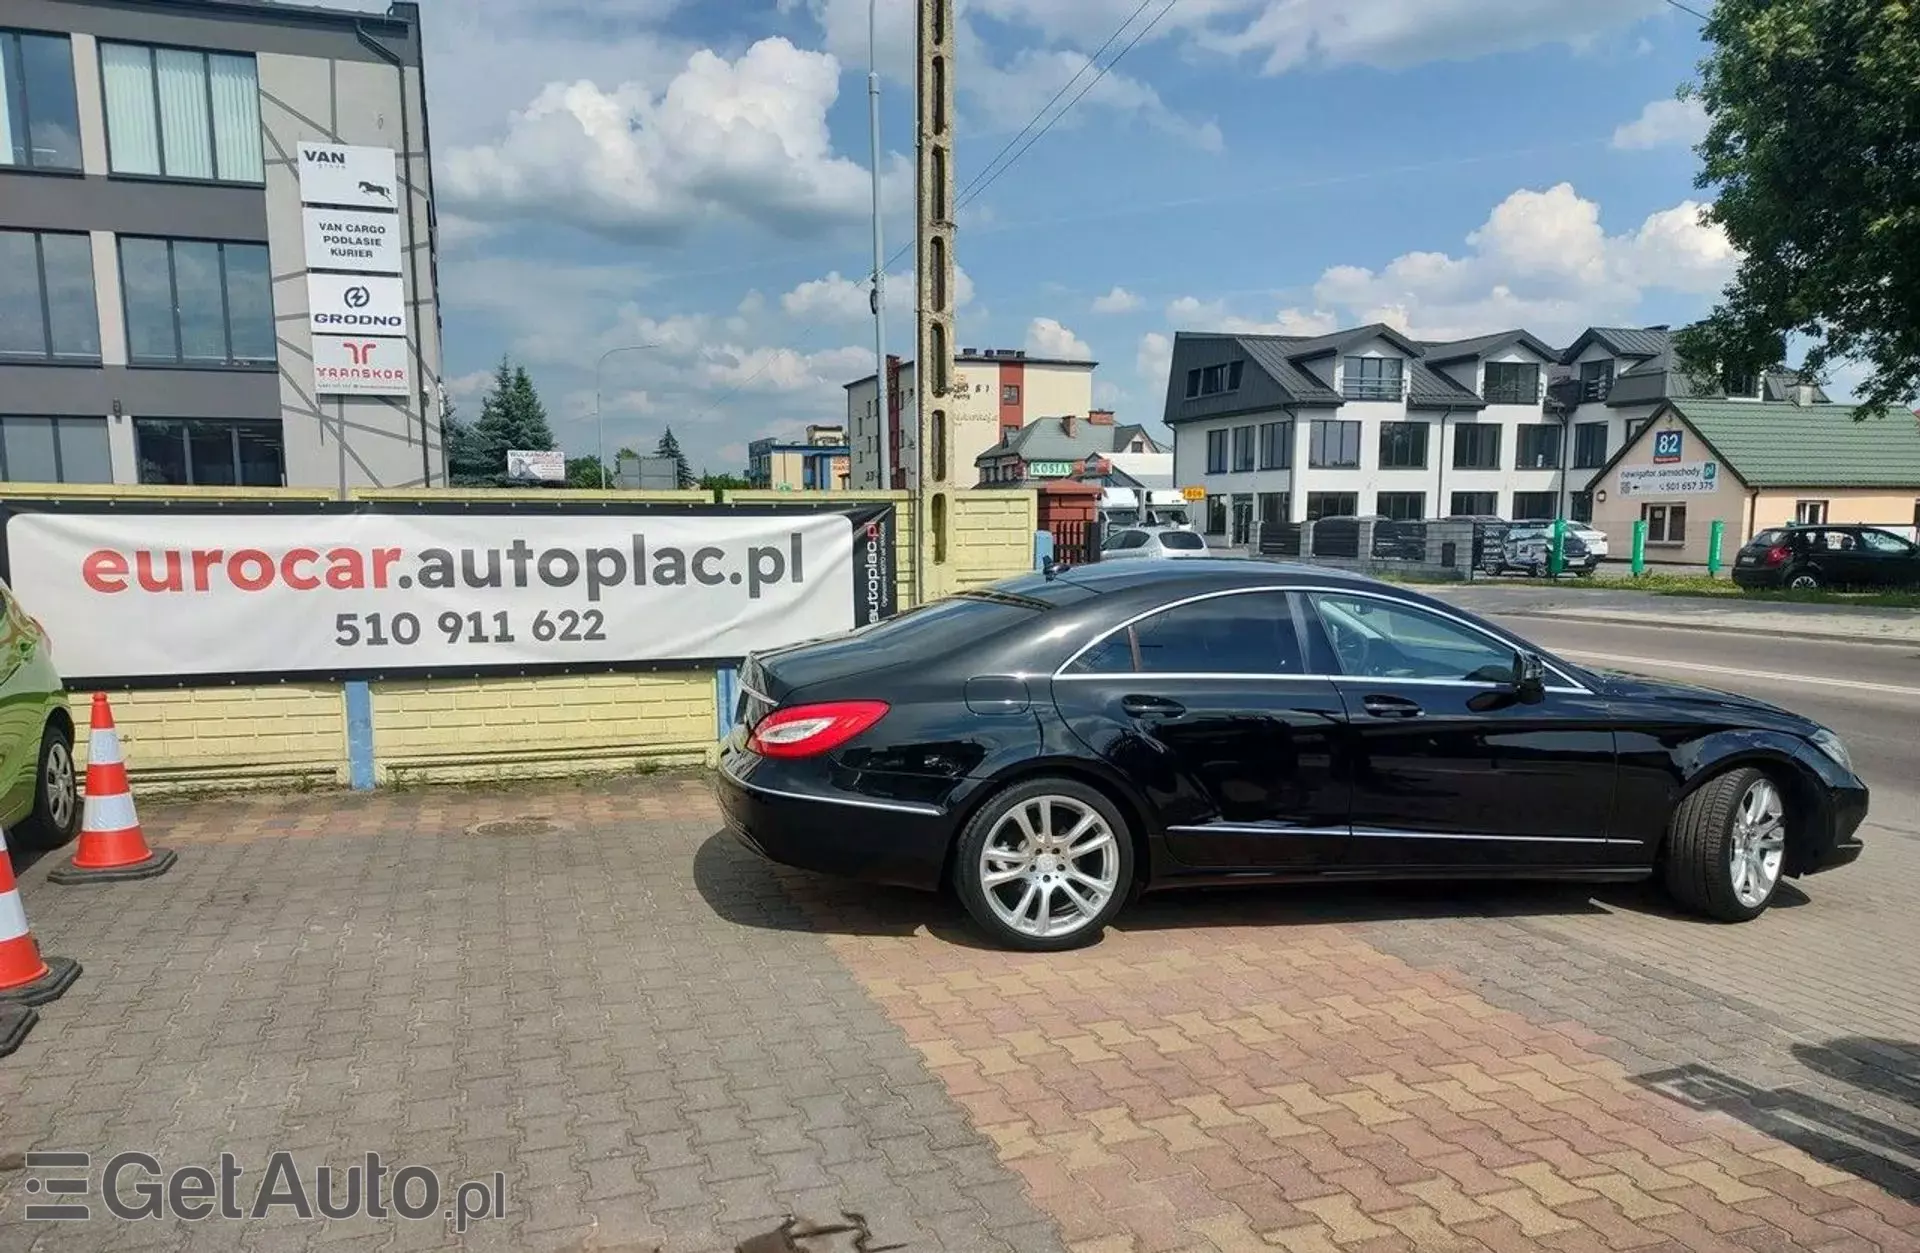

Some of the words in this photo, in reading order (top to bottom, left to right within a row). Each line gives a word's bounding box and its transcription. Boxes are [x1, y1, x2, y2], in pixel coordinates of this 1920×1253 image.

[304, 150, 345, 163] VAN
[319, 222, 342, 232] VAN
[345, 223, 386, 234] CARGO
[323, 235, 382, 246] PODLASIE
[330, 248, 373, 258] KURIER
[314, 313, 402, 327] GRODNO
[316, 367, 404, 379] TRANSKOR
[1659, 433, 1679, 454] 82
[1682, 481, 1697, 490] 657
[82, 532, 804, 601] eurocar.autoplac.pl
[864, 522, 880, 623] autoplac.pl
[335, 612, 421, 646] 510
[438, 610, 515, 644] 911
[532, 609, 607, 642] 622
